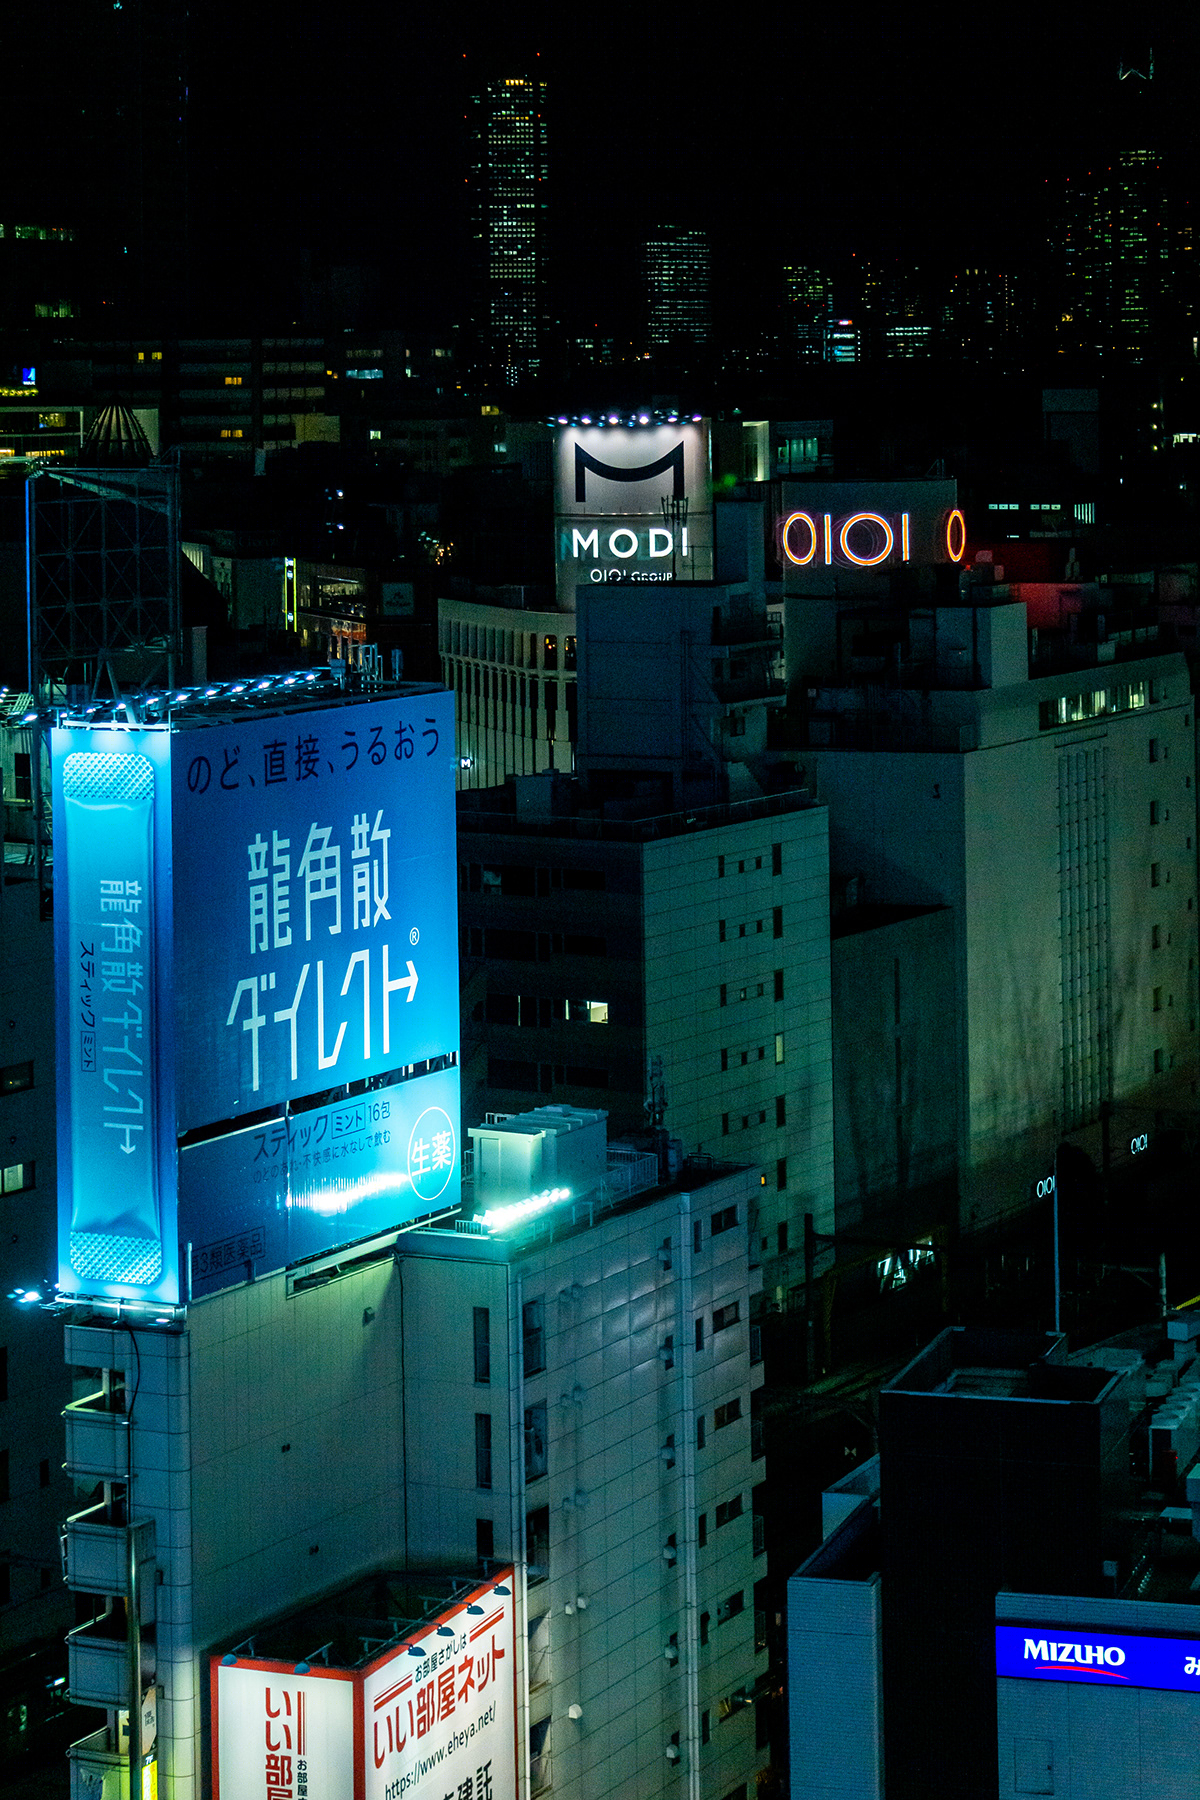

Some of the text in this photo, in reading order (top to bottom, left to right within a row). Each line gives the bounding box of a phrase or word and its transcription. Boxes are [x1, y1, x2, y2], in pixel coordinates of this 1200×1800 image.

[572, 527, 688, 558] MODI
[187, 717, 440, 795] のど、直接、うるおう
[248, 809, 391, 954] 龍角散
[226, 945, 418, 1092] ダイレクト
[335, 1109, 363, 1132] ミント
[411, 1130, 451, 1177] 生薬
[415, 1633, 467, 1684] お部屋さがしは
[1023, 1638, 1126, 1666] MIZUHO
[373, 1634, 505, 1769] いい部屋ネット
[385, 1700, 496, 1800] https://www.eheya.net/
[297, 1759, 308, 1800] お部屋
